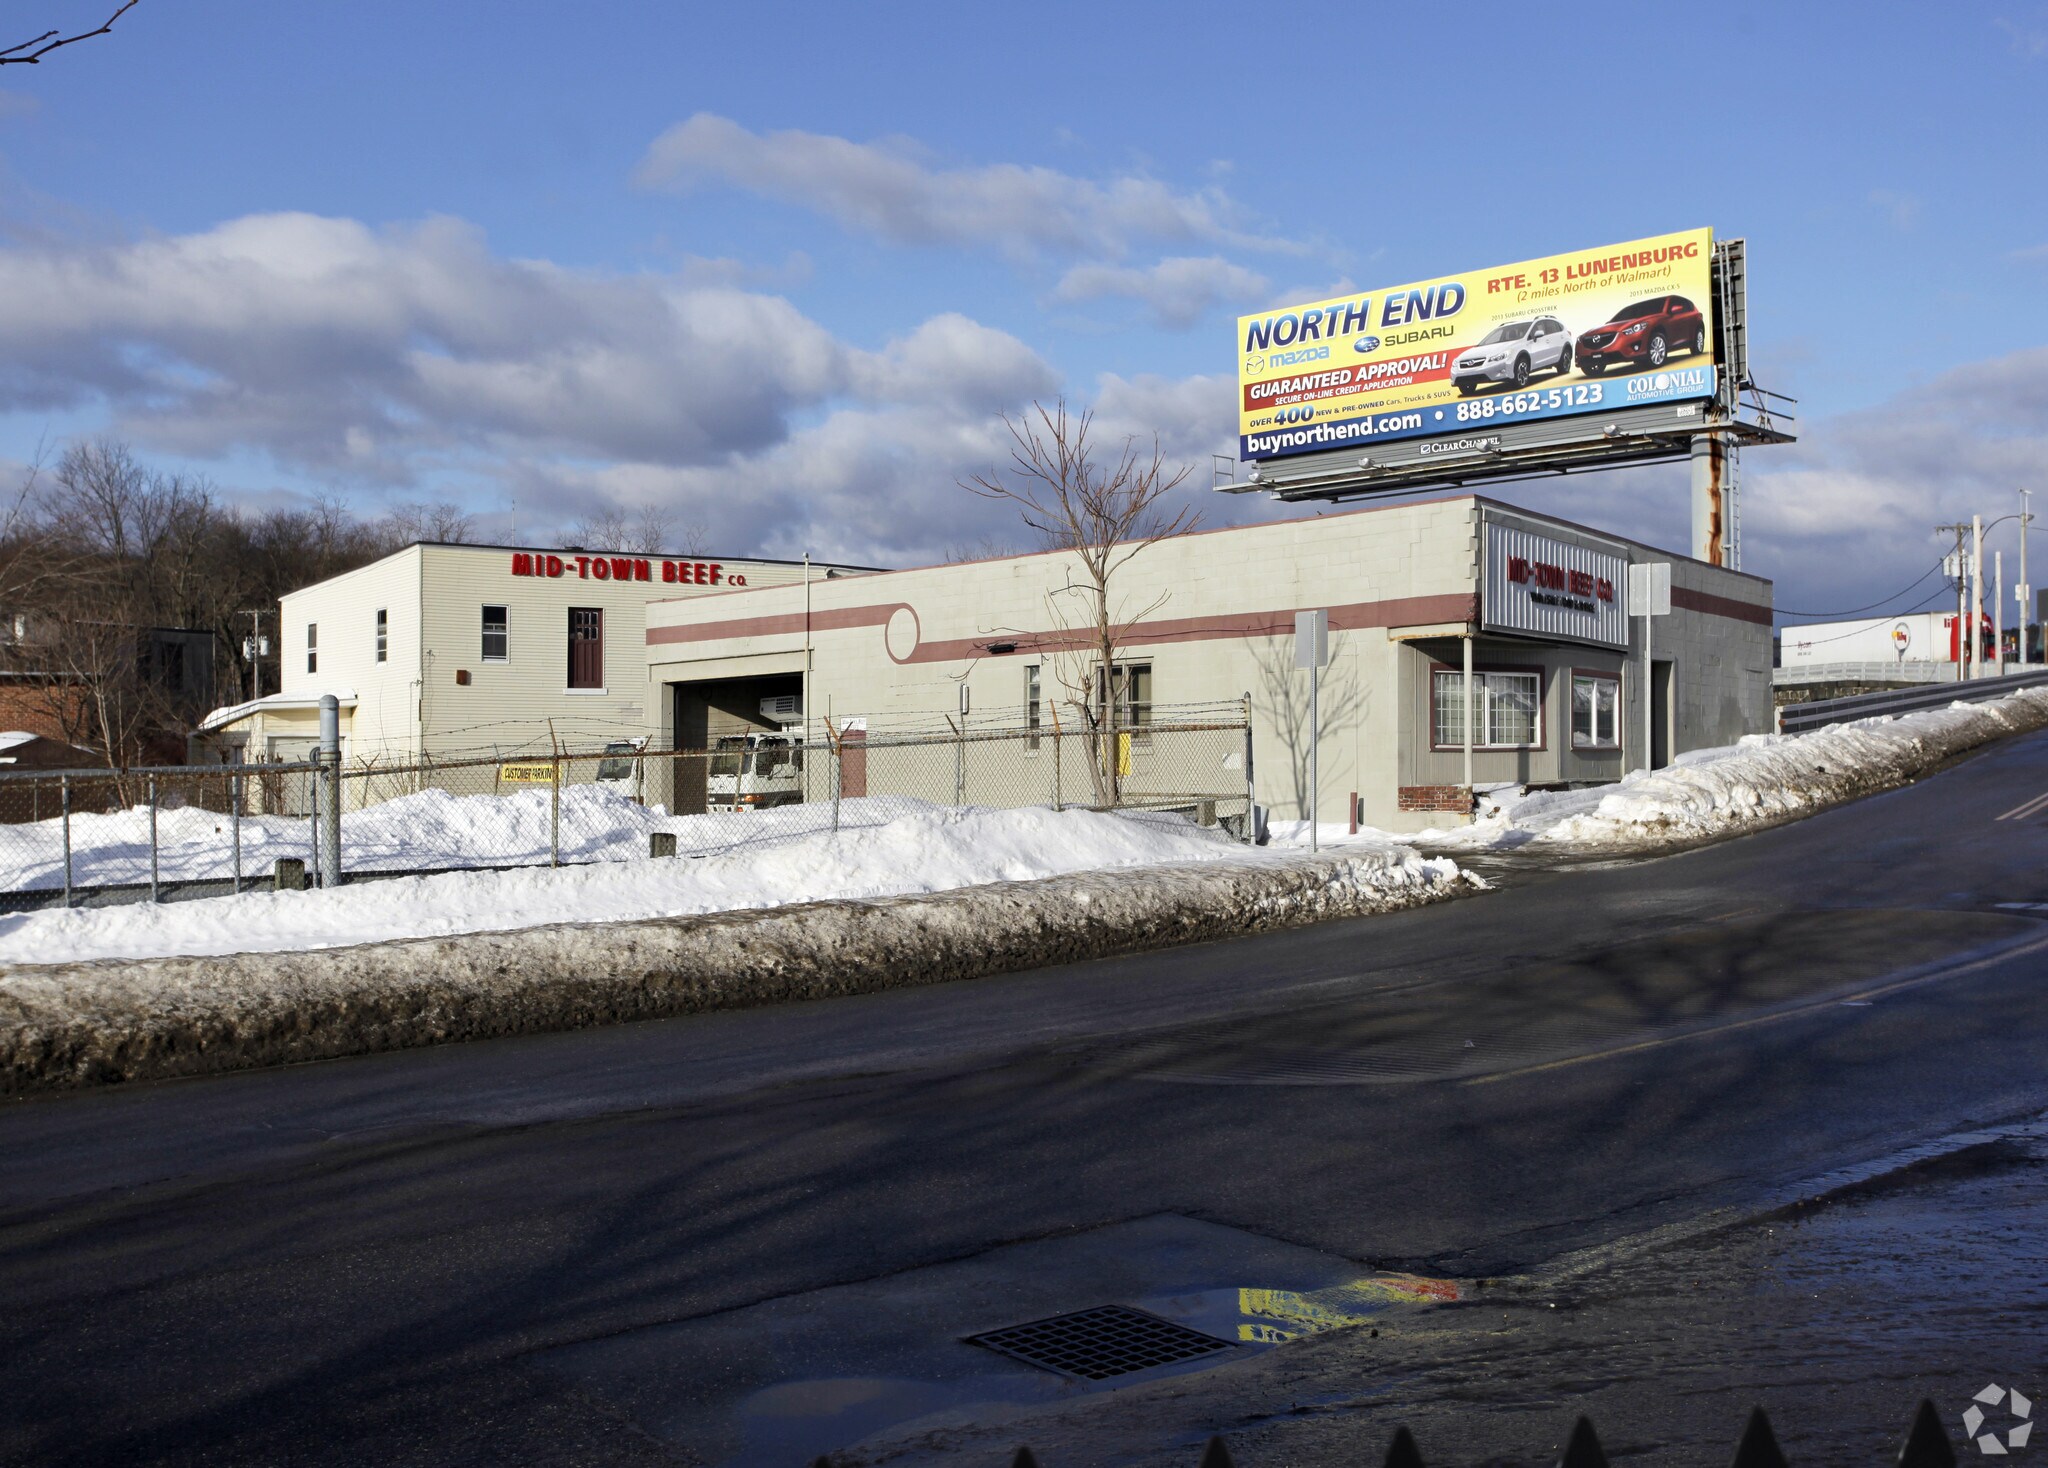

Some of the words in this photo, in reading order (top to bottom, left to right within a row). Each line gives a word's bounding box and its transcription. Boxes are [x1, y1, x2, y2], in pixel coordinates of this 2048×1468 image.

[1487, 274, 1532, 294] RTE.
[1539, 268, 1559, 284] 13
[1566, 242, 1698, 280] LUNENBURG
[1517, 291, 1528, 303] (2
[1531, 286, 1560, 299] miles
[1563, 279, 1597, 294] North
[1600, 275, 1614, 287] of
[1616, 265, 1671, 284] Walmart)
[1644, 286, 1666, 295] MAZDA
[1245, 299, 1370, 353] NORTH
[1380, 283, 1466, 328] END
[1505, 309, 1526, 319] SUBARU
[1527, 305, 1558, 315] CROSSTREK
[1385, 325, 1454, 346] SUBARU
[1269, 346, 1330, 369] mazda
[1250, 369, 1352, 399] GUARANTEED
[1355, 353, 1447, 382] APPROVAL!
[1275, 394, 1302, 406] SECURE
[1303, 389, 1333, 400] ON-LINE
[1335, 384, 1362, 396] CREDIT
[1362, 376, 1413, 393] APPLICATION
[1627, 388, 1674, 401] AUTOMOTIVE
[1677, 384, 1704, 395] GROUP
[1247, 413, 1422, 453] buynorthend.com
[1456, 383, 1603, 421] 888-662-5123
[1250, 418, 1272, 427] OVER
[1274, 405, 1314, 426] 400
[1316, 408, 1332, 416] NEW
[1342, 400, 1384, 412] PRE-OWNED
[1404, 394, 1425, 403] Trucks
[511, 553, 650, 581] MID-TOWN
[662, 561, 722, 585] BEEF
[1507, 555, 1564, 591] MID-TOWN
[1568, 570, 1593, 597] BEEF
[504, 767, 531, 779] CUSTOMER
[532, 767, 552, 779] PARKIN
